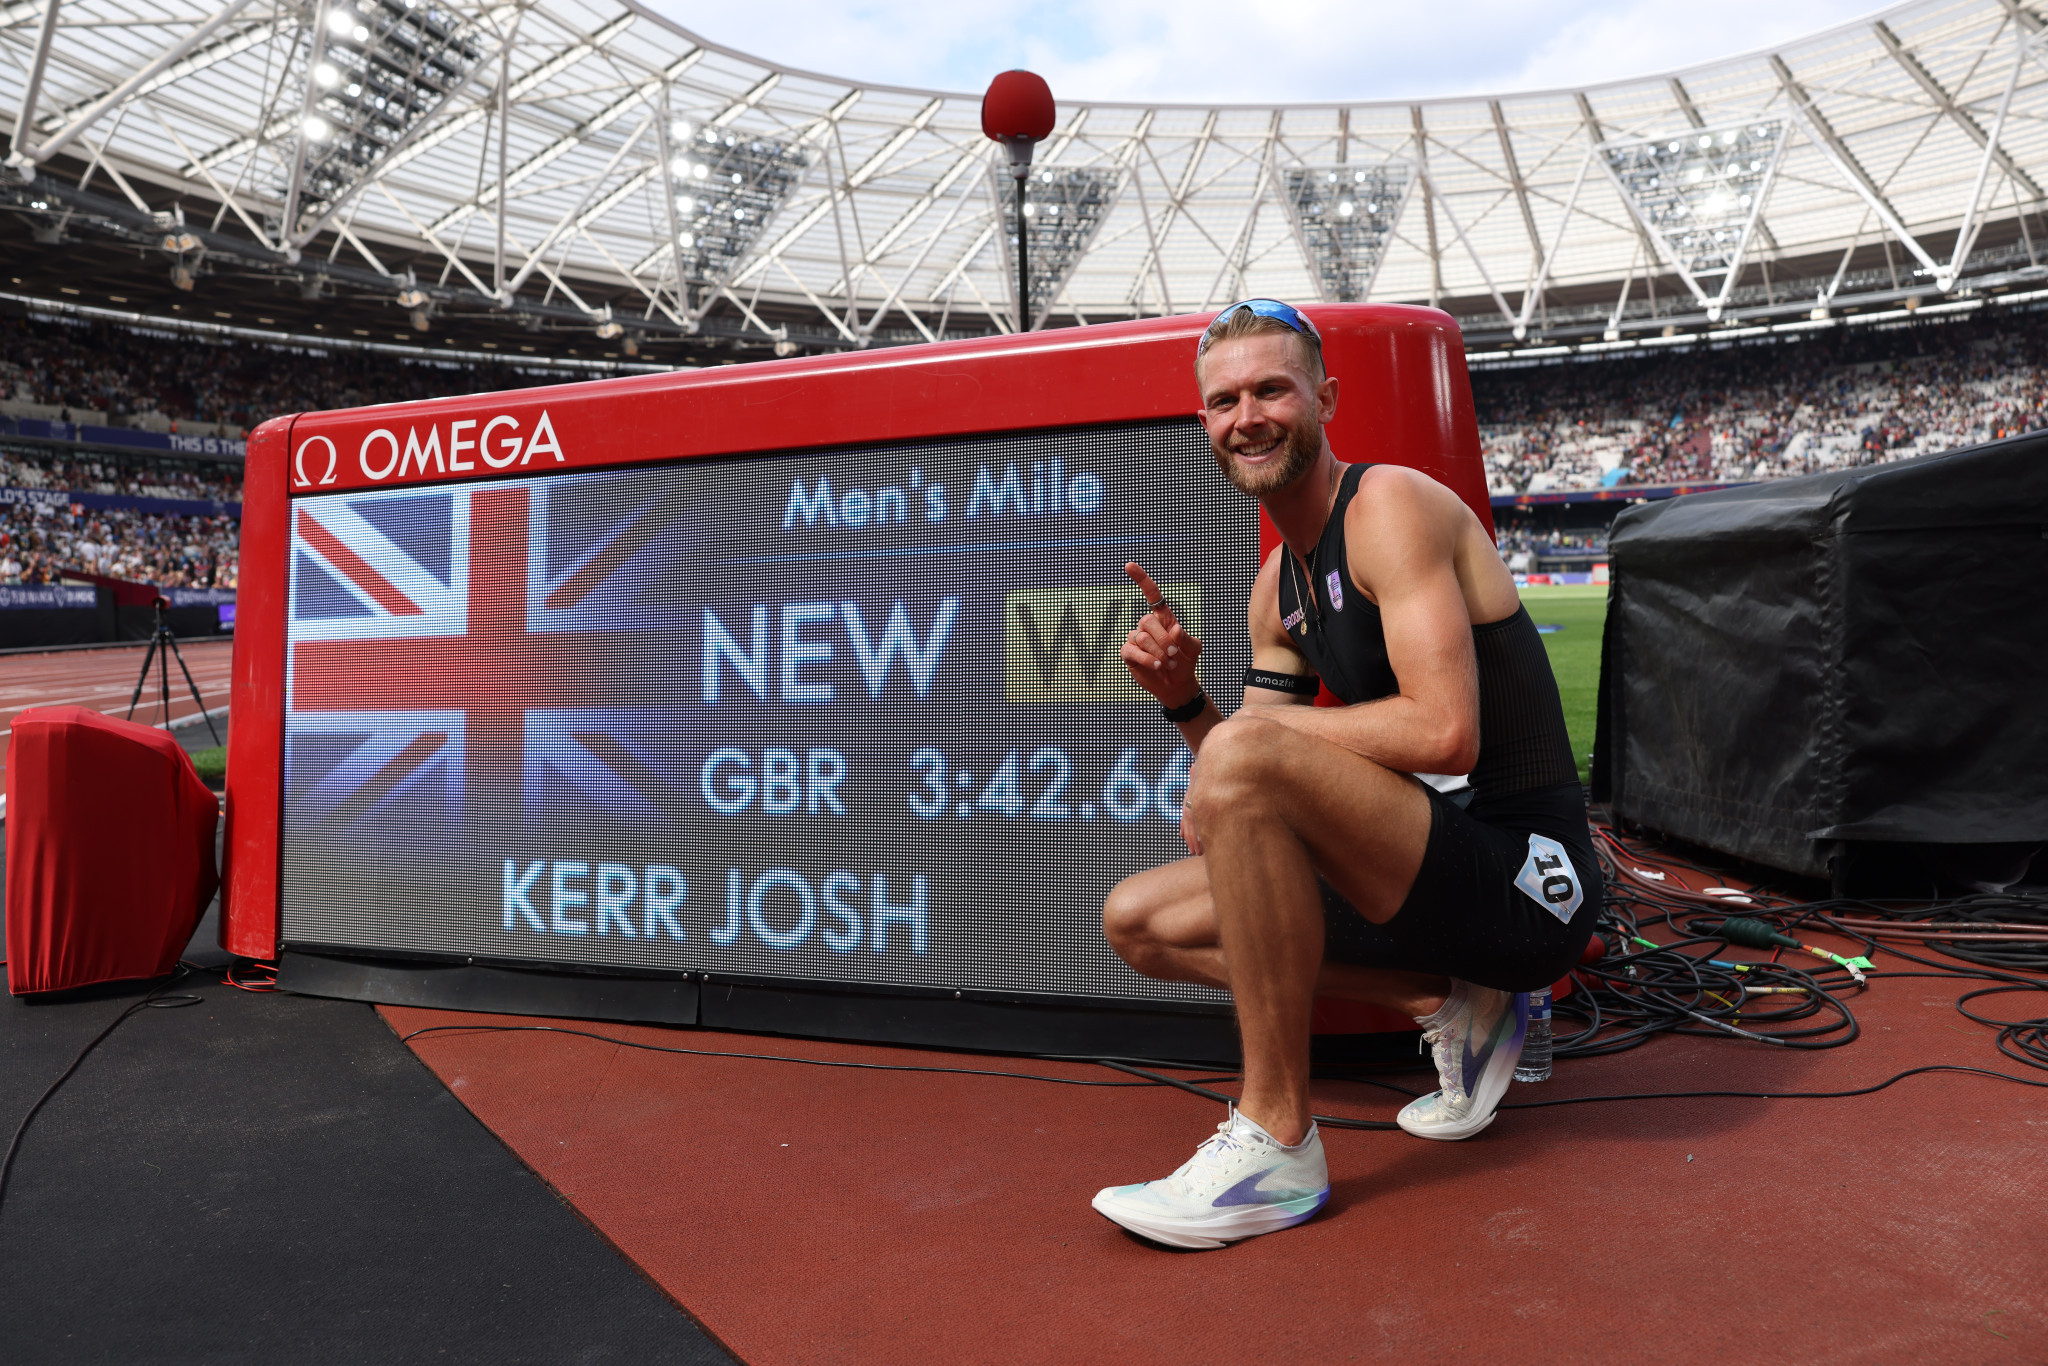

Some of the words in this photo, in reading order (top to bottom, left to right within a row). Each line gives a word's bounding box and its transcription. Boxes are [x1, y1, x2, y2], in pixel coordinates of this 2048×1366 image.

[168, 434, 202, 453] THIS
[203, 438, 218, 454] IS
[359, 409, 566, 480] OMEGA
[781, 465, 949, 531] Men's
[966, 456, 1101, 519] Mile
[702, 595, 961, 704] NEW
[1255, 676, 1295, 688] amazfit
[702, 746, 849, 816] GBR
[502, 858, 688, 943] KERR
[709, 866, 930, 956] JOSH
[1533, 854, 1574, 904] 10
